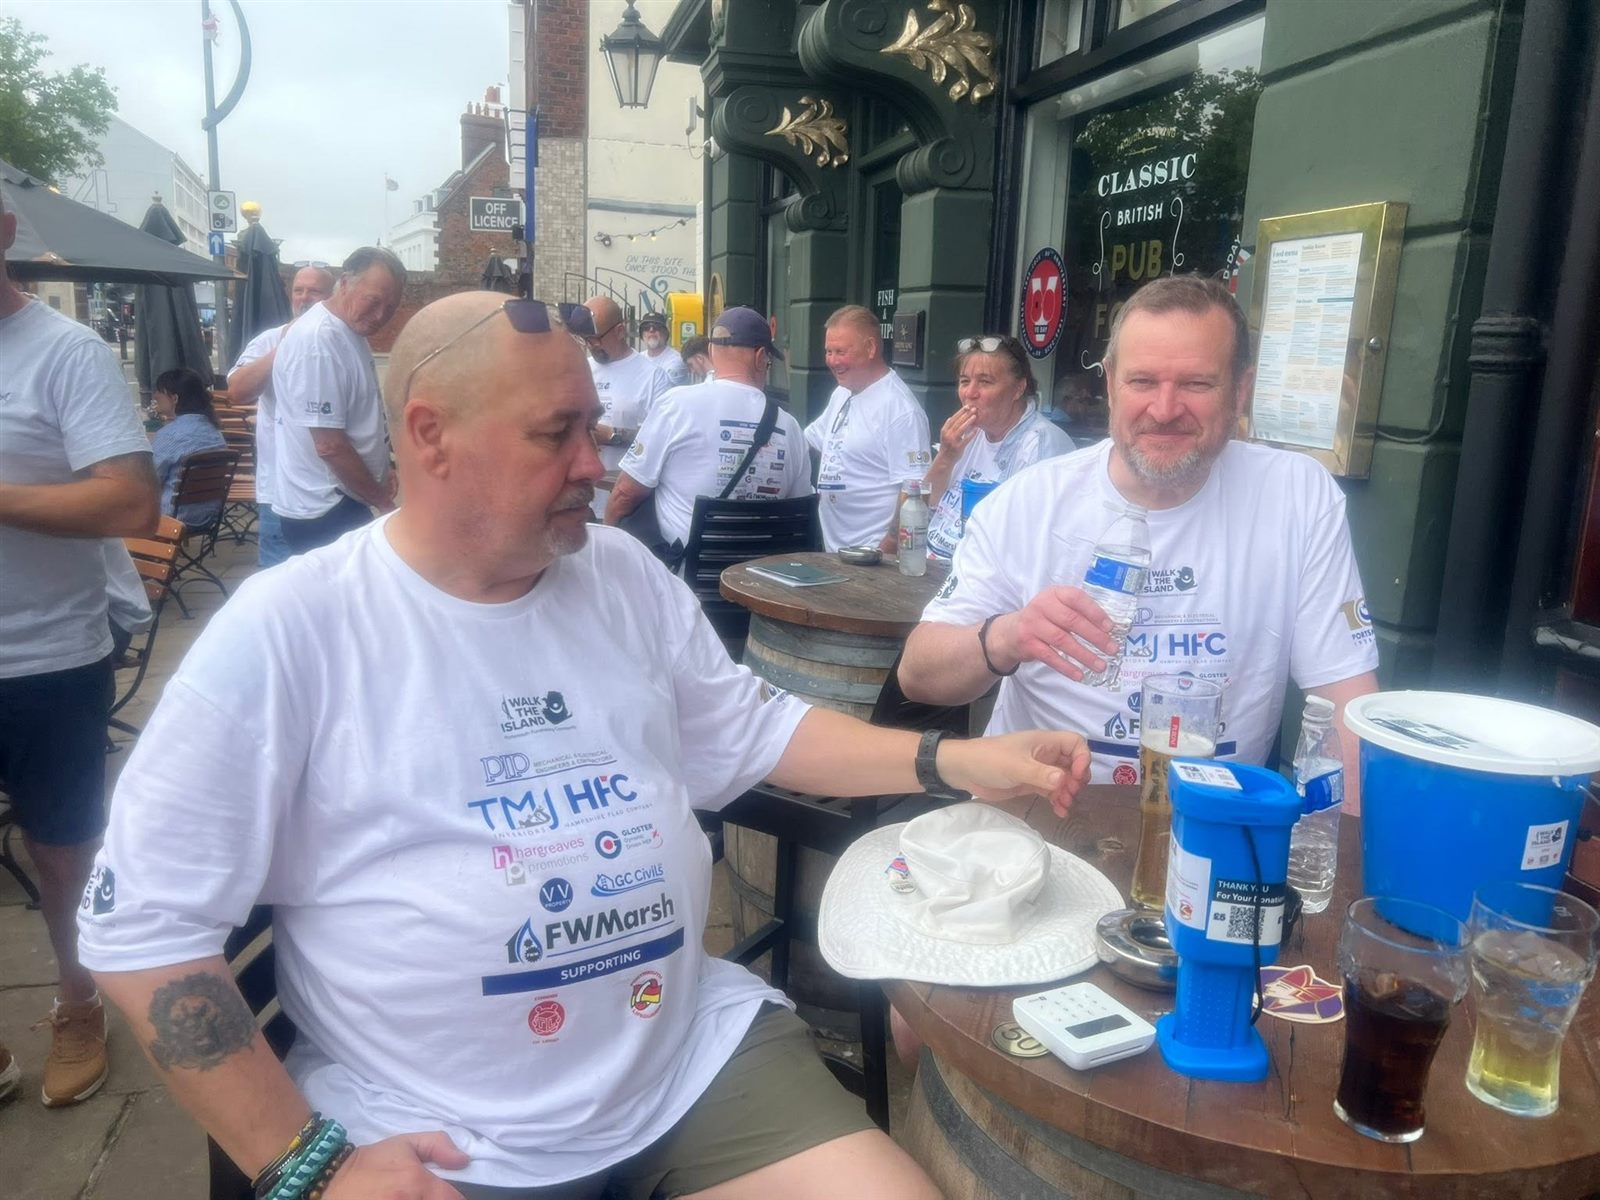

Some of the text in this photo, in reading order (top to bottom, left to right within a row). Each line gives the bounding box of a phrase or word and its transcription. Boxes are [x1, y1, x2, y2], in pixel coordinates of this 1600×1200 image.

[1098, 153, 1197, 197] CLASSIC
[485, 203, 507, 214] OFF
[1117, 203, 1163, 226] BRITISH
[474, 215, 518, 228] LICENCE
[625, 263, 647, 273] ONCE
[651, 265, 679, 275] STOOD
[642, 256, 660, 265] THIS
[664, 256, 683, 266] SITE
[1111, 240, 1163, 281] PUB
[878, 289, 894, 306] FISH
[1151, 569, 1177, 578] WALK
[1154, 577, 1171, 585] THE
[1143, 585, 1174, 594] SLAND
[1125, 632, 1227, 663] MJ HFC
[508, 696, 542, 708] WALK
[515, 706, 540, 718] THE
[500, 716, 546, 733] ISLAND
[480, 752, 530, 783] PIP
[467, 773, 638, 831] TMJ HFC
[621, 823, 654, 837] GLOSTER
[515, 837, 585, 859] hargreaves
[528, 852, 589, 874] promotions
[615, 863, 665, 889] GC Civils
[1218, 880, 1270, 893] THANK YU
[1216, 891, 1231, 899] For
[1232, 893, 1252, 902] Your
[545, 893, 675, 950] FWMarsh
[560, 950, 641, 980] SUPPORTING
